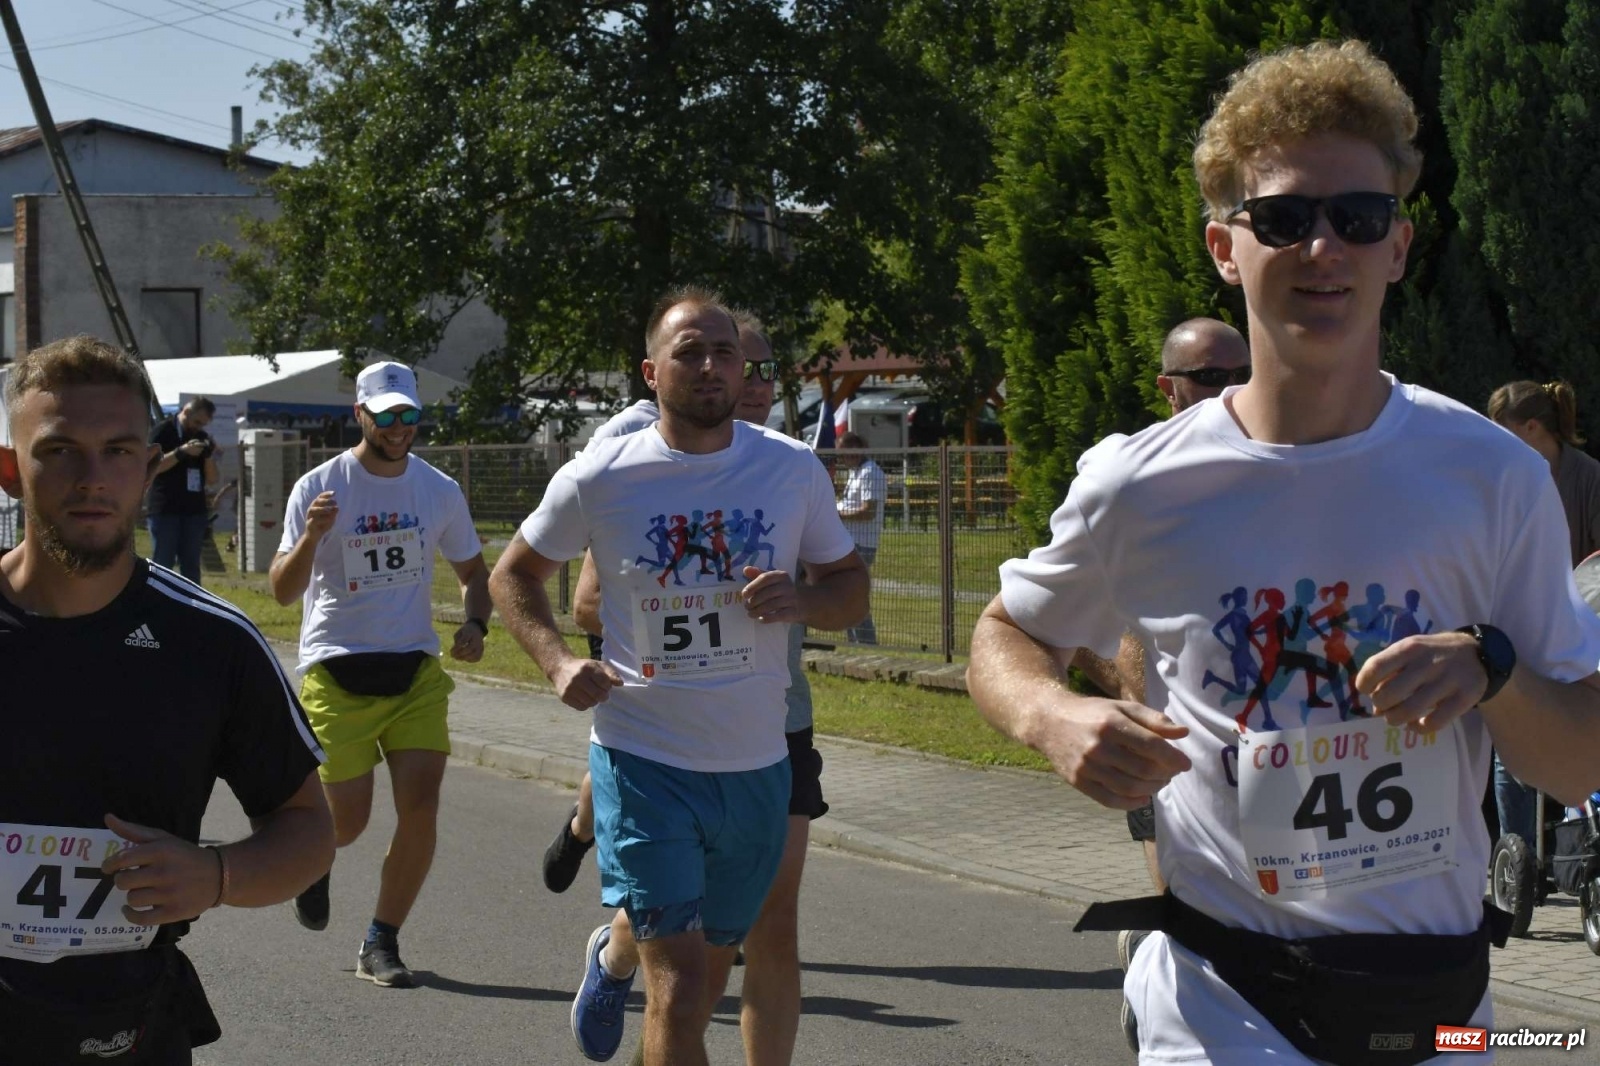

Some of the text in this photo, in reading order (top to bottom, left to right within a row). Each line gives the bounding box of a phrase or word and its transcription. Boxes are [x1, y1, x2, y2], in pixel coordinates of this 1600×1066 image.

[348, 535, 390, 548] COLOUR
[363, 546, 405, 572] 18
[641, 594, 705, 611] COLOUR
[125, 638, 160, 649] adidas
[663, 612, 721, 651] 51
[714, 647, 752, 657] 05.09.2021
[1253, 731, 1369, 770] COLOUR
[1293, 762, 1413, 841] 46
[0, 832, 92, 861] OLOUR
[1254, 856, 1295, 867] 10km,
[1300, 842, 1379, 864] Krzanowice,
[1386, 827, 1450, 849] 05.09.2021
[17, 864, 115, 920] 47
[0, 921, 14, 931] m,
[19, 922, 87, 935] Krzanowice,
